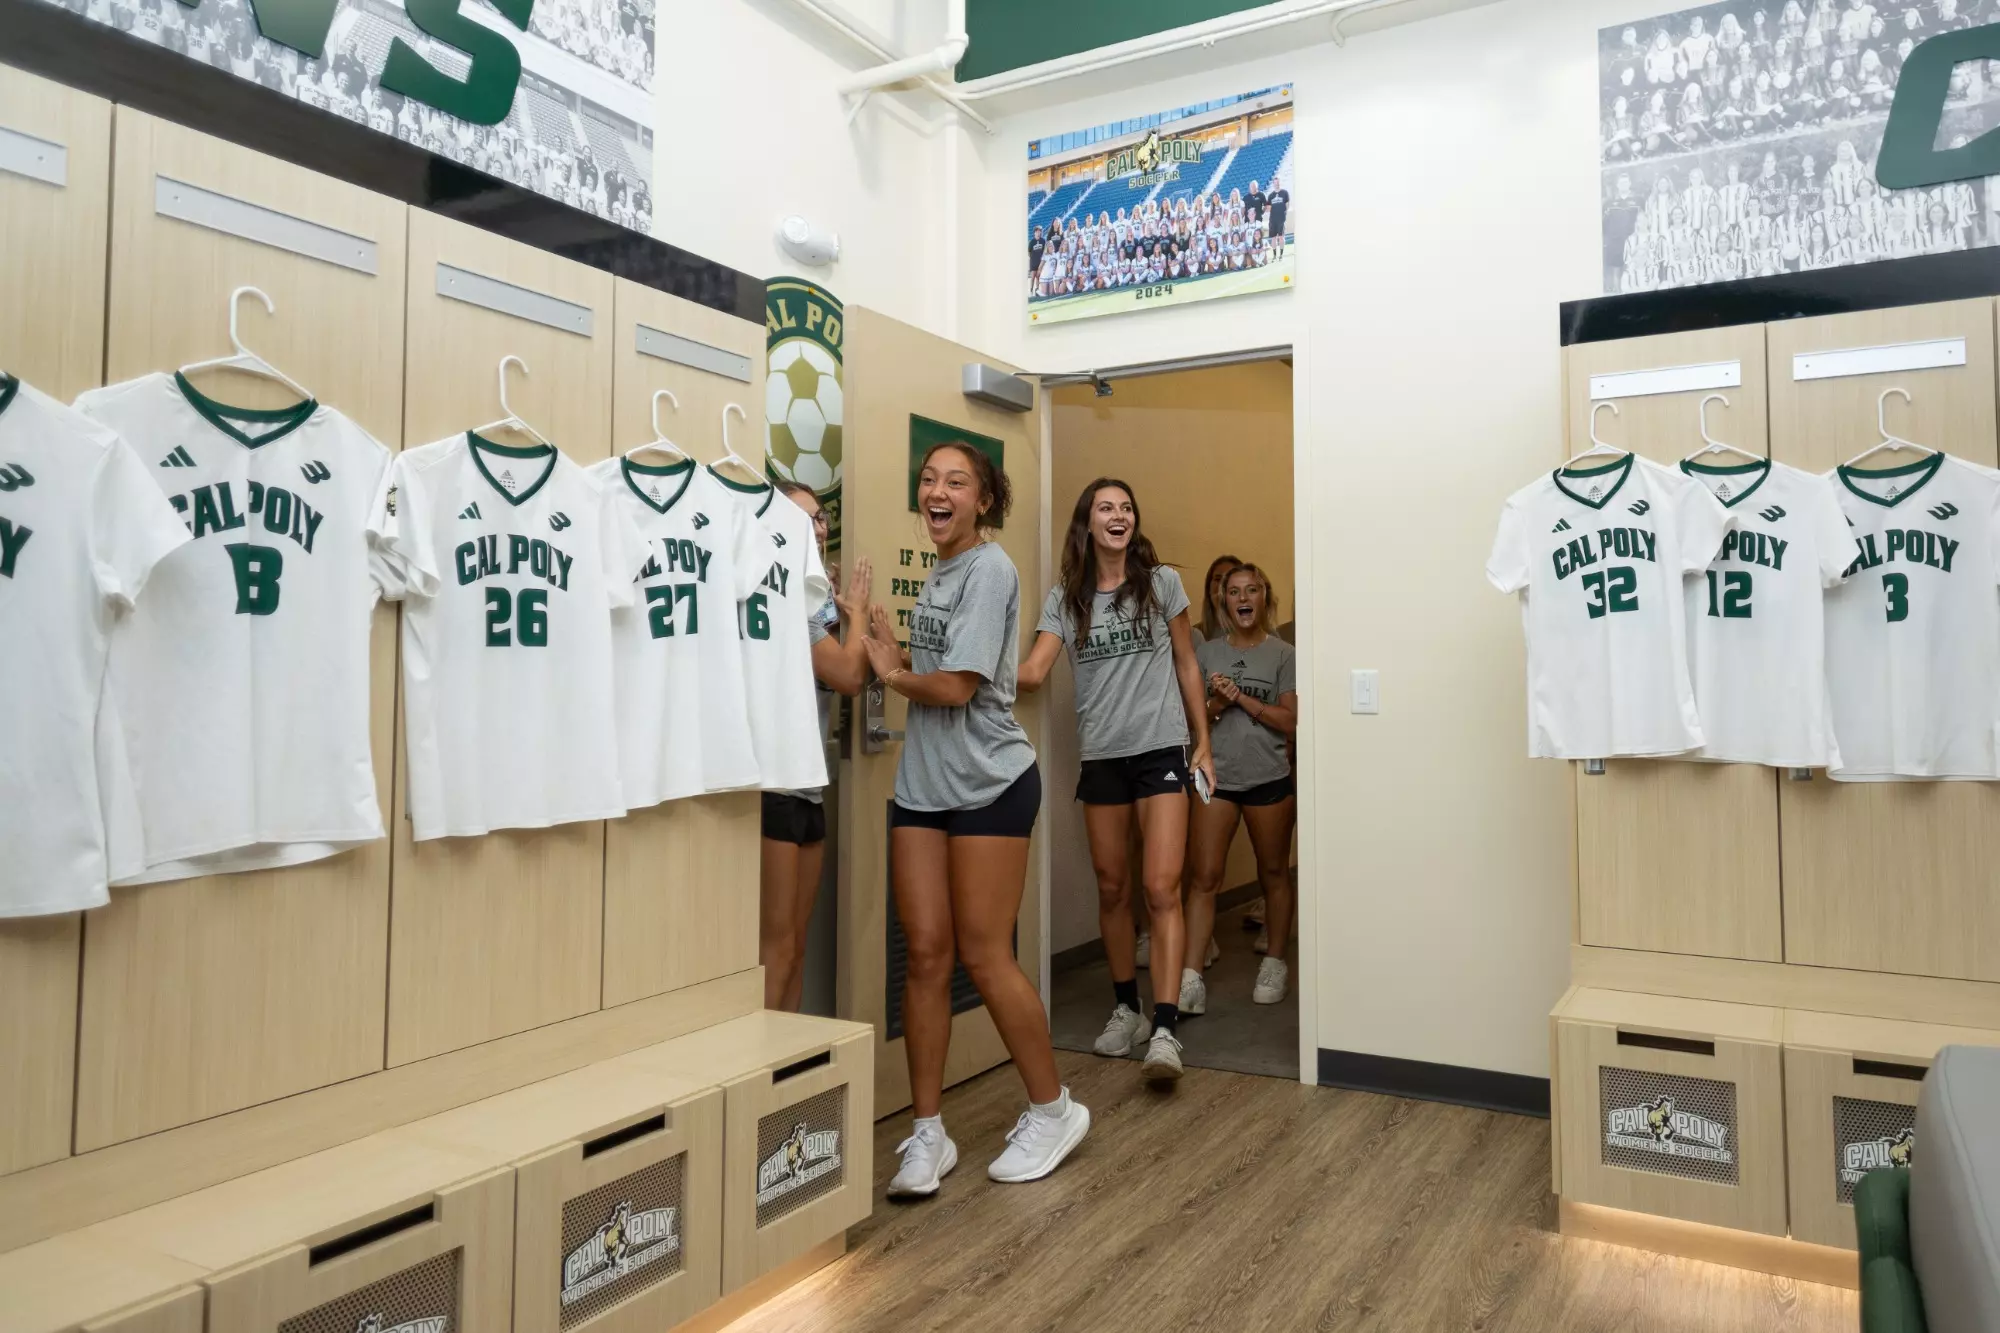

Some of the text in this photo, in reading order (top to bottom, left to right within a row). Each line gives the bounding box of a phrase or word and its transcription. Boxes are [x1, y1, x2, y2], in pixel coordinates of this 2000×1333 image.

[1106, 140, 1204, 182] CAL POLY
[1129, 170, 1181, 189] SOCCER
[1136, 284, 1173, 300] 2024
[805, 301, 842, 348] PO
[247, 479, 324, 555] POLY
[455, 534, 574, 592] CAL POLY
[900, 549, 938, 568] IF YO
[1553, 527, 1656, 580] CAL POLY
[1720, 528, 1789, 571] POLY
[1884, 528, 1960, 573] POLY
[224, 543, 283, 616] B
[1581, 565, 1640, 619] 32
[1705, 569, 1753, 618] 12
[1882, 572, 1909, 623] 3
[485, 587, 548, 647] 26
[644, 583, 698, 639] 27
[1120, 640, 1153, 652] SOCCER
[1609, 1107, 1728, 1149] CAL POLY
[759, 1131, 839, 1191] CAL POLY
[803, 1155, 840, 1182] SOCCER
[1674, 1144, 1734, 1163] SOCCER
[1845, 1143, 1890, 1169] CAL
[565, 1208, 675, 1289] CAL POLY
[627, 1237, 679, 1272] SOCCER
